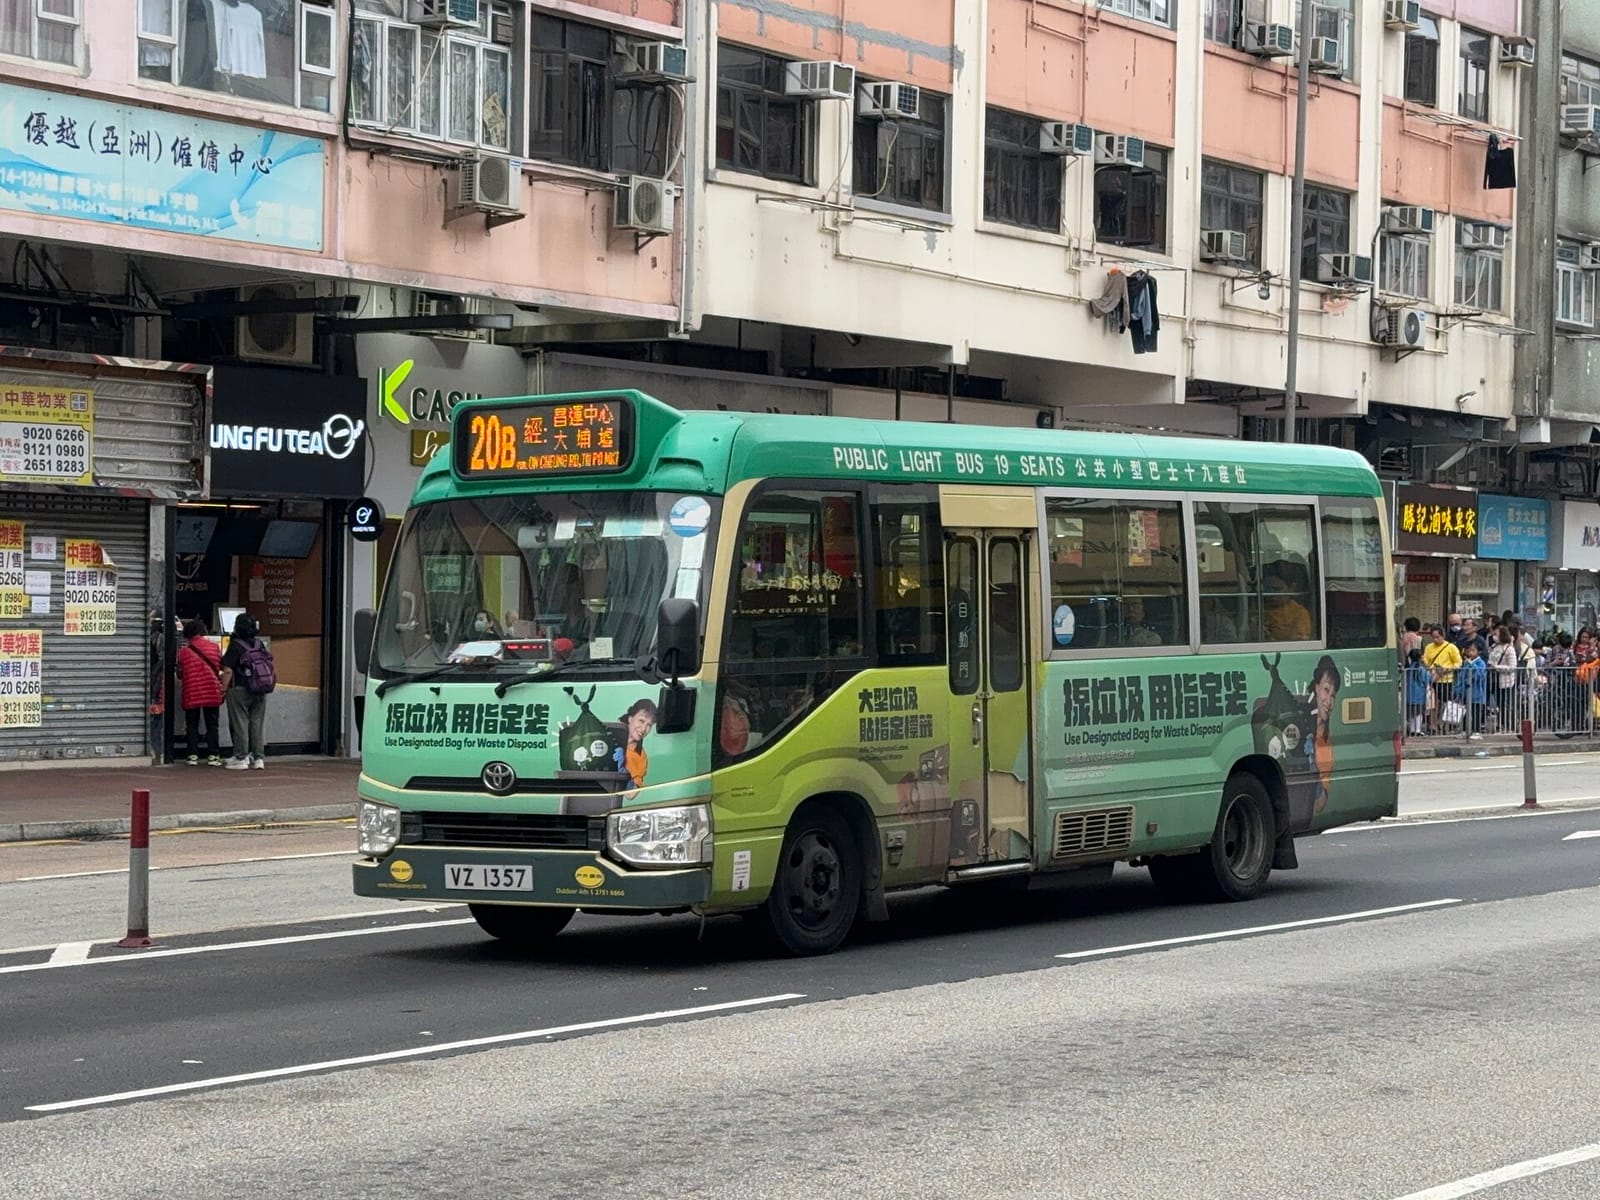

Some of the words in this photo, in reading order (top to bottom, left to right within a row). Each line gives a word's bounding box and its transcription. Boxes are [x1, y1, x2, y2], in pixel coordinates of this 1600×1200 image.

[5, 390, 67, 409] 中華物業
[377, 359, 414, 424] K
[410, 386, 482, 423] CAS
[554, 404, 614, 428] 昌運中心
[22, 427, 52, 440] 9020
[56, 429, 84, 442] 6266
[470, 415, 516, 470] 20B
[23, 443, 52, 456] 9121
[56, 445, 84, 457] 0980
[24, 459, 52, 472] 2651
[56, 461, 84, 472] 8283
[833, 447, 888, 471] PUBLIC
[900, 450, 942, 472] LIGHT
[955, 452, 984, 474] BUS
[994, 454, 1009, 475] 19
[1020, 455, 1064, 477] SEATS
[1075, 458, 1247, 484] 公共小型巴士十九座位
[66, 590, 90, 603] 9020
[92, 590, 116, 603] 6266
[80, 610, 96, 620] 9121
[0, 632, 40, 655] 華物業
[16, 681, 40, 694] 6266
[4, 702, 20, 712] 9121
[859, 686, 918, 713] 大型垃圾
[4, 714, 20, 724] 2651
[385, 737, 398, 746] Use
[398, 737, 444, 749] Designated
[445, 738, 462, 750] Bag
[464, 738, 476, 748] for
[477, 738, 506, 749] Waste
[507, 739, 547, 750] Disposal
[1064, 732, 1081, 746] Use
[1082, 728, 1132, 746] Designated
[1134, 727, 1150, 743] Bag
[1150, 726, 1163, 738] for
[1164, 724, 1190, 738] Waste
[1190, 722, 1224, 739] Disposal
[450, 868, 474, 887] VZ
[483, 868, 526, 888] 1357
